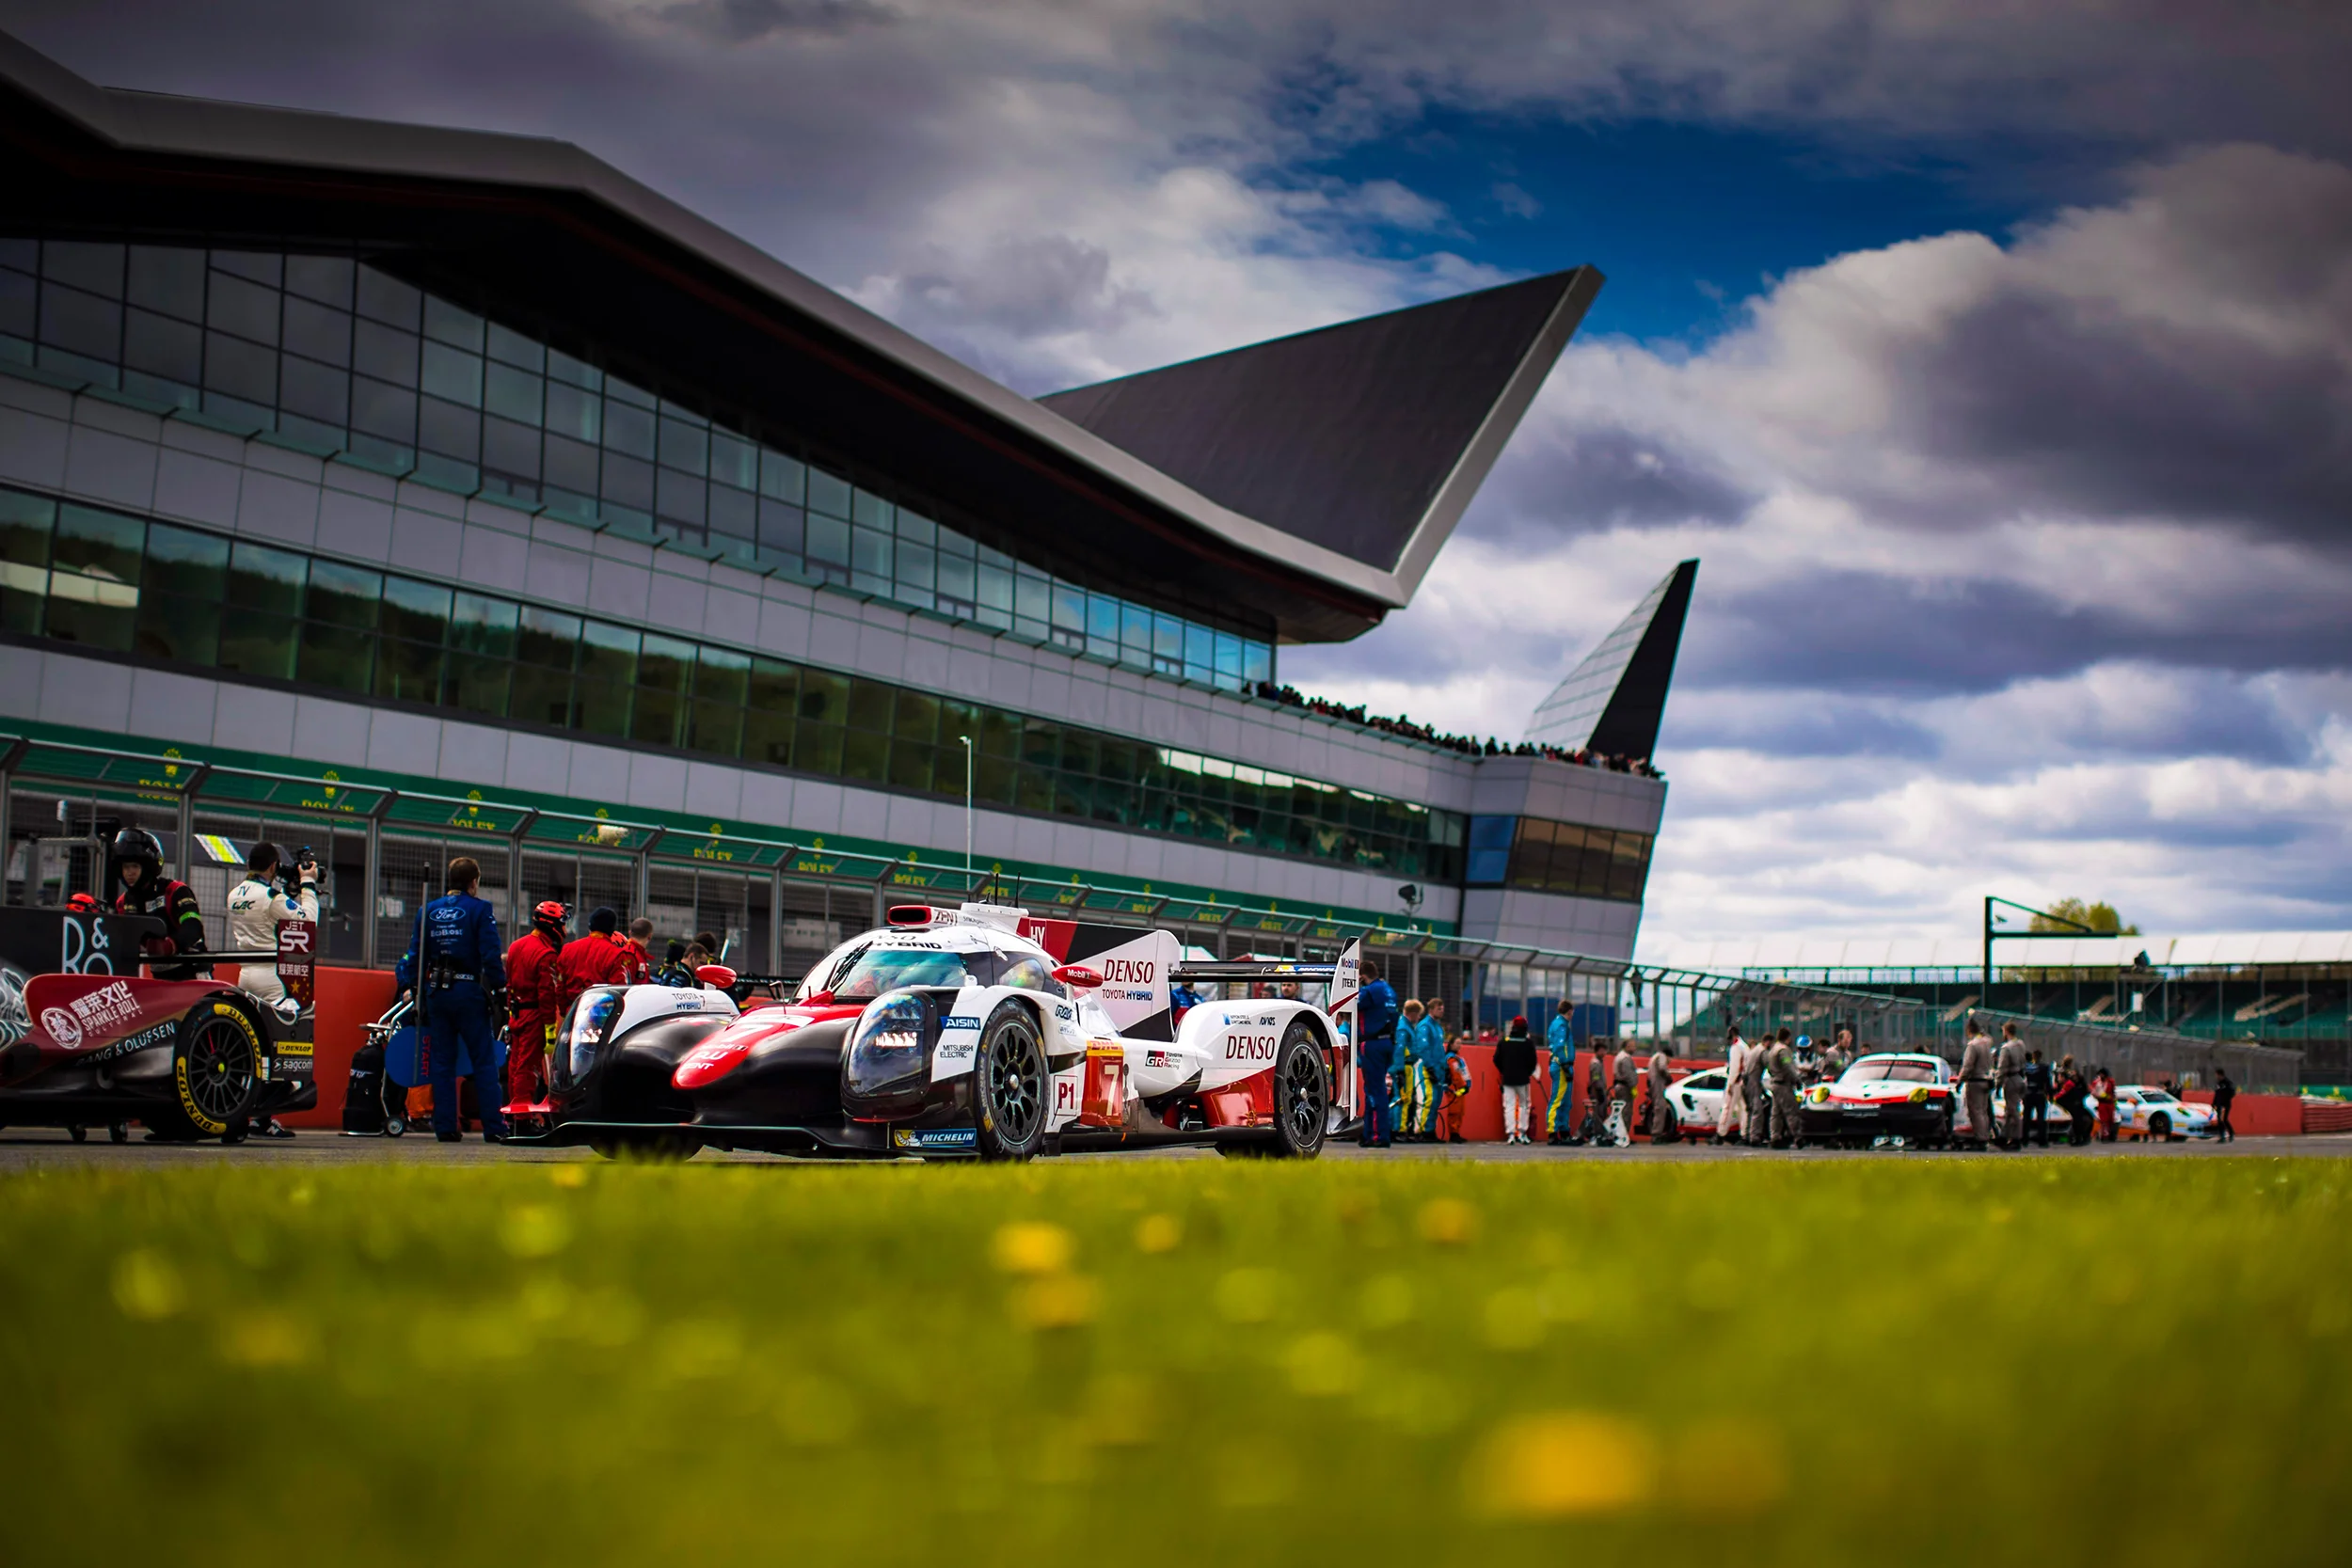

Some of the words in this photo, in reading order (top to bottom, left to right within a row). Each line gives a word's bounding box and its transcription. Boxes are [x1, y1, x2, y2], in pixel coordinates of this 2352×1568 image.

[285, 922, 305, 931] JET
[1067, 968, 1086, 978] Mobil
[1104, 959, 1154, 984] DENSO
[1342, 978, 1357, 989] JTEKT
[676, 1002, 702, 1010] HYBRID
[1102, 989, 1126, 1000] TOYOTA
[1126, 990, 1152, 1001] HYBRID
[81, 1006, 119, 1032] SPARKLE
[117, 997, 140, 1017] ROLL
[946, 1018, 979, 1028] AISIN
[124, 1022, 176, 1052] OLUFSEN
[228, 1008, 262, 1065] DUNLOP
[1225, 1035, 1276, 1060] DENSO
[421, 1036, 432, 1078] START
[1147, 1056, 1164, 1067] GR
[177, 1066, 217, 1132] DUNLOP
[1058, 1082, 1074, 1110] P1
[1104, 1064, 1120, 1117] 7
[921, 1132, 975, 1143] MICHELIN
